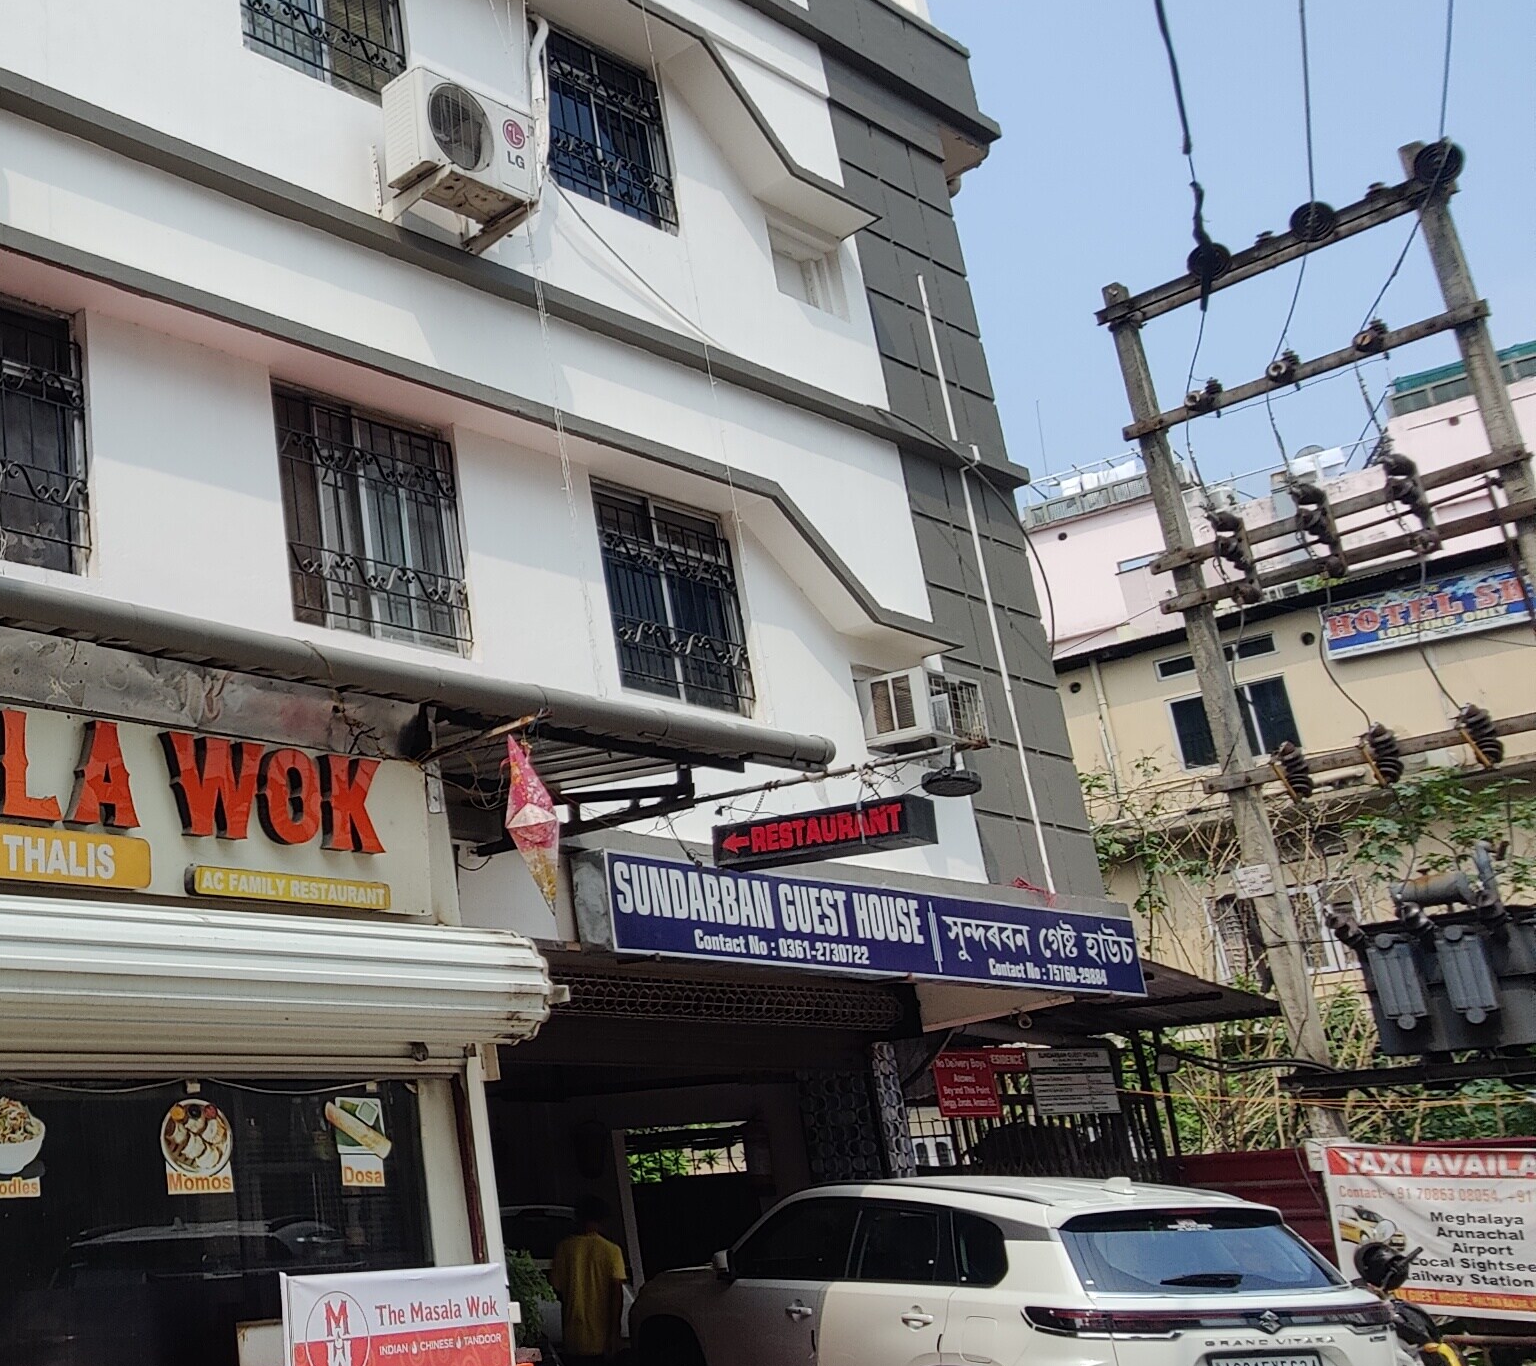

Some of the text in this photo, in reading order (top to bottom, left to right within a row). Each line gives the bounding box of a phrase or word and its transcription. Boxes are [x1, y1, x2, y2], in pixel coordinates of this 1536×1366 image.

[507, 151, 525, 169] LG
[1327, 593, 1463, 640] HOTEL
[1463, 605, 1508, 622] ONLY
[160, 732, 386, 854] WOK
[751, 803, 902, 852] RESTAURANT
[2, 835, 116, 880] THALIS
[201, 871, 385, 906] AC FAMILY RESTAURANT
[613, 861, 925, 945] SUNDARBAN GUEST HOUSE
[694, 928, 747, 954] Contact
[748, 934, 769, 956] No
[779, 937, 870, 965] 0361-2730722
[988, 957, 1026, 979] Contact
[1026, 961, 1041, 980] No
[1340, 1151, 1412, 1175] TAXI
[168, 1173, 232, 1192] Momos
[342, 1166, 383, 1185] Dosa
[1430, 1212, 1524, 1227] Meghalaya
[1436, 1227, 1525, 1241] Arunachal
[1452, 1242, 1515, 1257] Airport
[1406, 1270, 1535, 1288] ailway Station
[375, 1295, 500, 1326] The Masala Wok
[379, 1333, 503, 1356] INDIAN CHINESE TANDOOR
